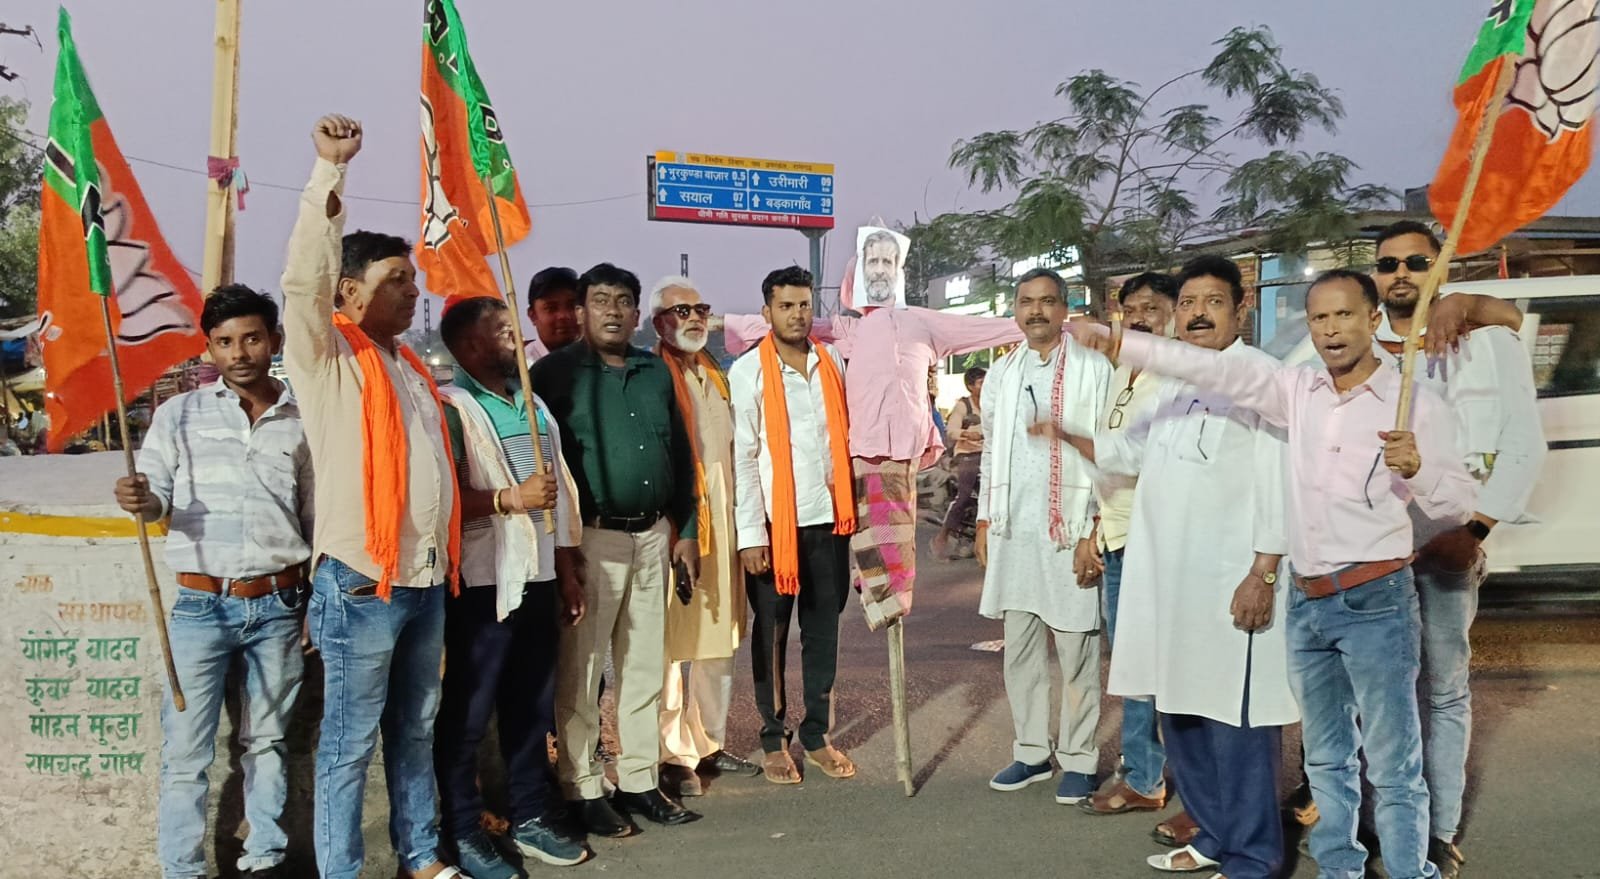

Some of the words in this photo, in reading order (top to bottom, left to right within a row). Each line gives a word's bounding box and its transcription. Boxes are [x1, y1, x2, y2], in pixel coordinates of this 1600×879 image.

[731, 171, 746, 181] 0.5
[768, 174, 809, 189] उरीमारी
[821, 177, 832, 187] 09
[679, 191, 713, 204] सयाल
[733, 192, 744, 202] 07
[86, 637, 140, 661] यादव
[86, 677, 141, 700] यादव
